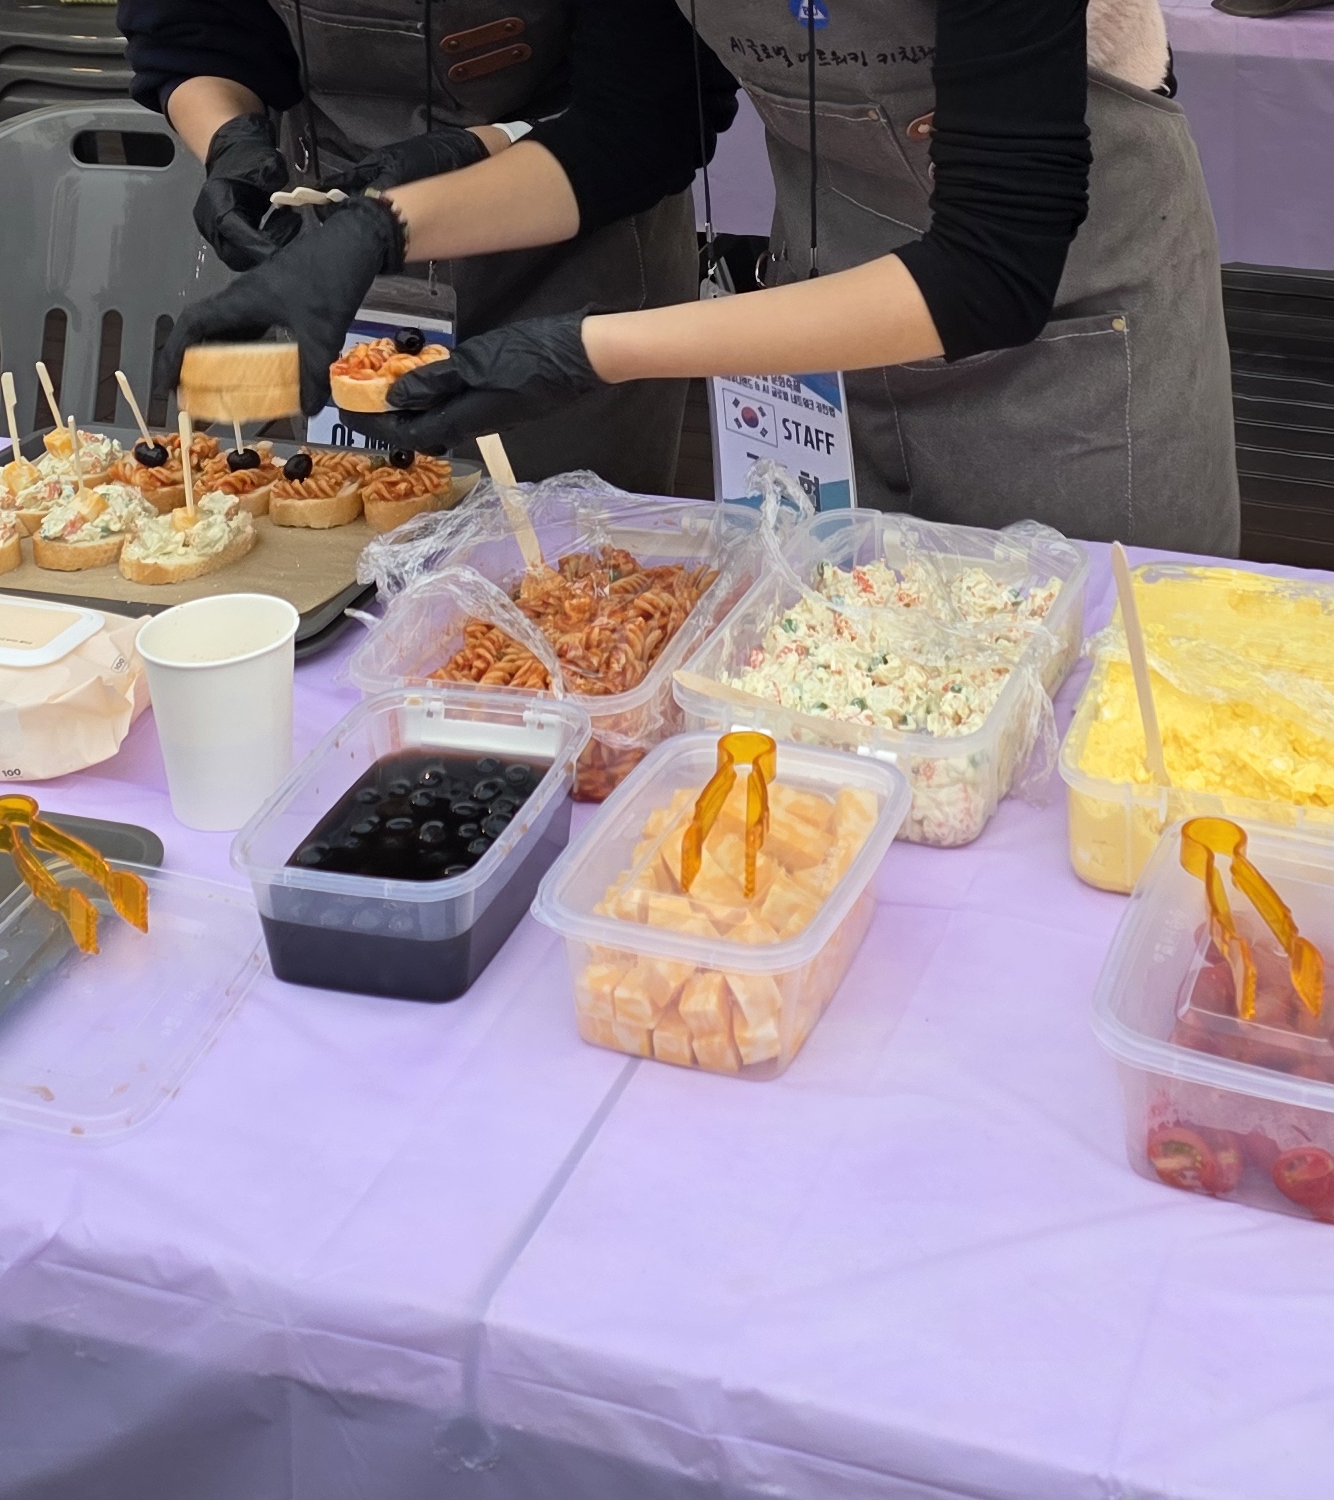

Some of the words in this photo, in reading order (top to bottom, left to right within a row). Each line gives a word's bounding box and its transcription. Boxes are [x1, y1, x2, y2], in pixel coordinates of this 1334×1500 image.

[746, 38, 794, 68] 글로벌
[782, 418, 835, 455] STAFF
[1, 768, 21, 777] 100
